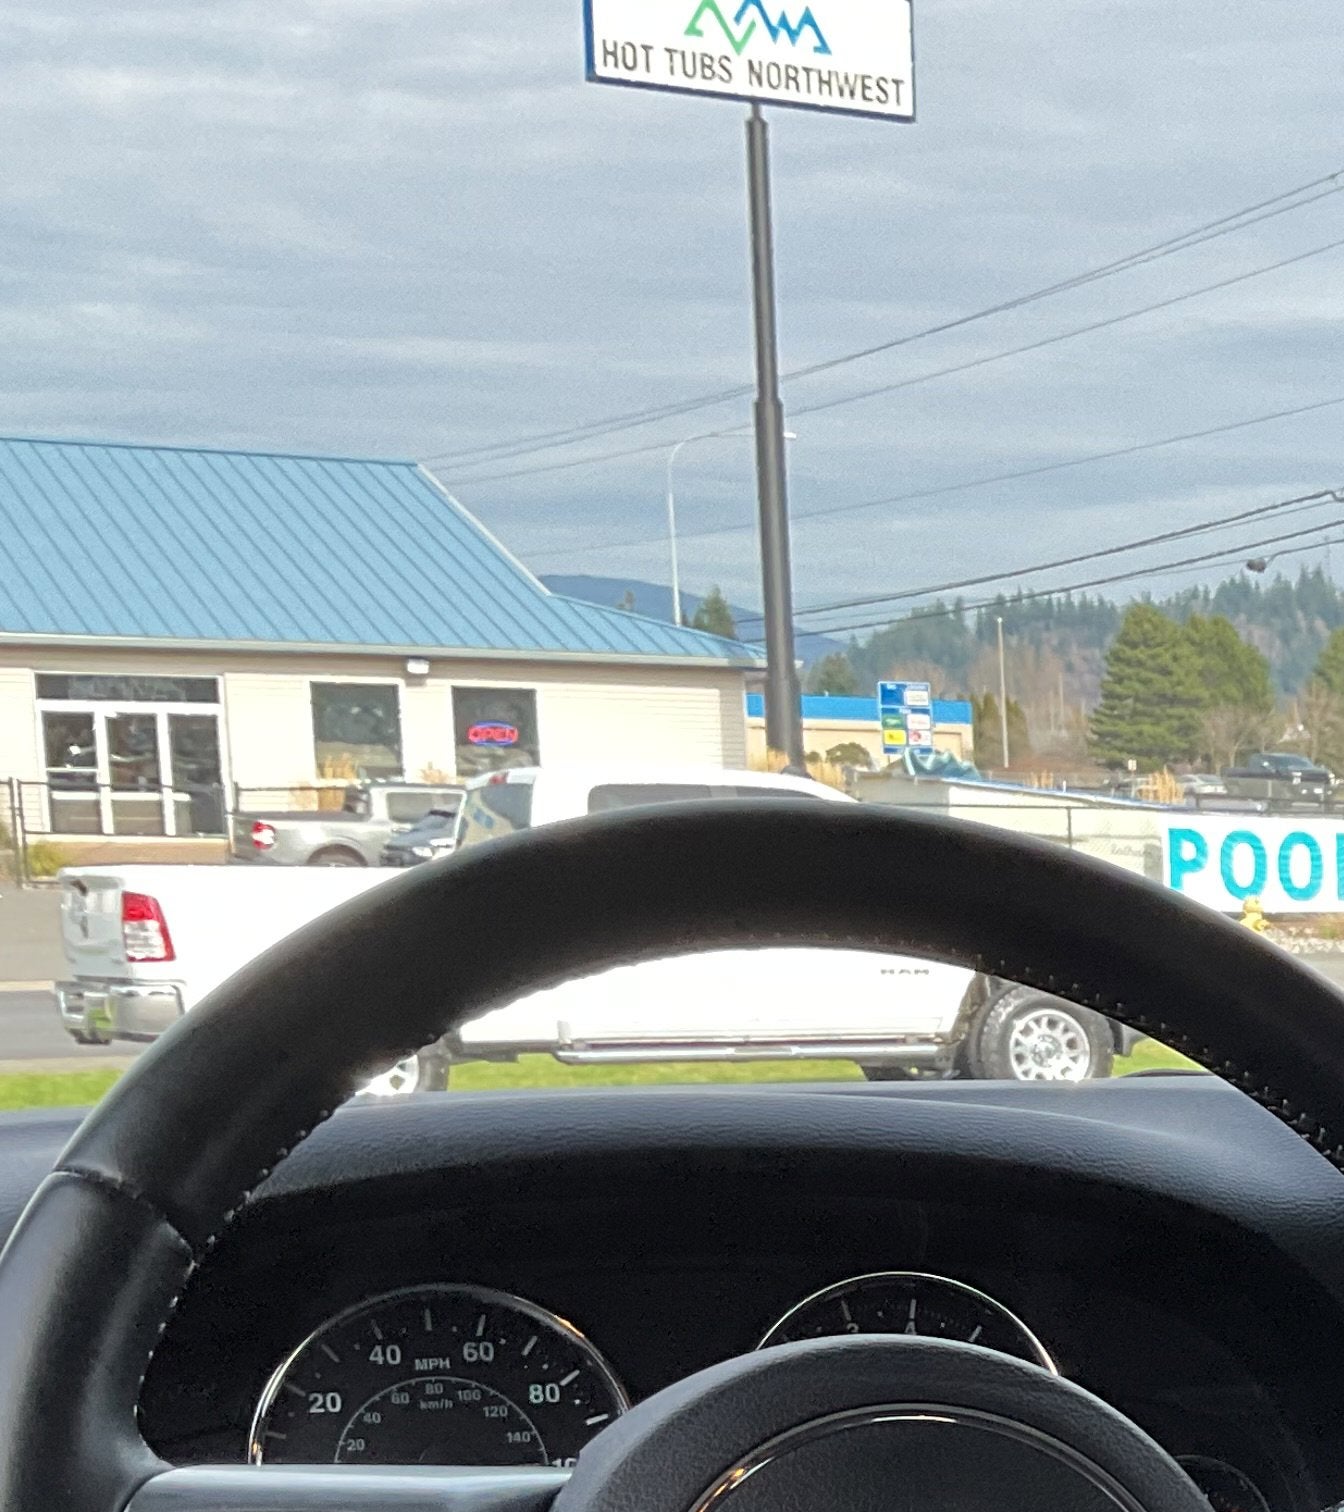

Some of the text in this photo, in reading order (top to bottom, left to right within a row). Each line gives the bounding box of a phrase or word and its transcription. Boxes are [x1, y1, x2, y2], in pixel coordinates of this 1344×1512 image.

[602, 40, 905, 106] HOT TUBS NORTHWEST
[468, 727, 519, 743] OPEN
[369, 1344, 401, 1366] 40
[462, 1341, 495, 1363] 60
[415, 1357, 451, 1372] MPH
[308, 1391, 342, 1414] 20
[528, 1383, 561, 1405] 80
[362, 1411, 382, 1425] 40
[346, 1437, 366, 1451] 20
